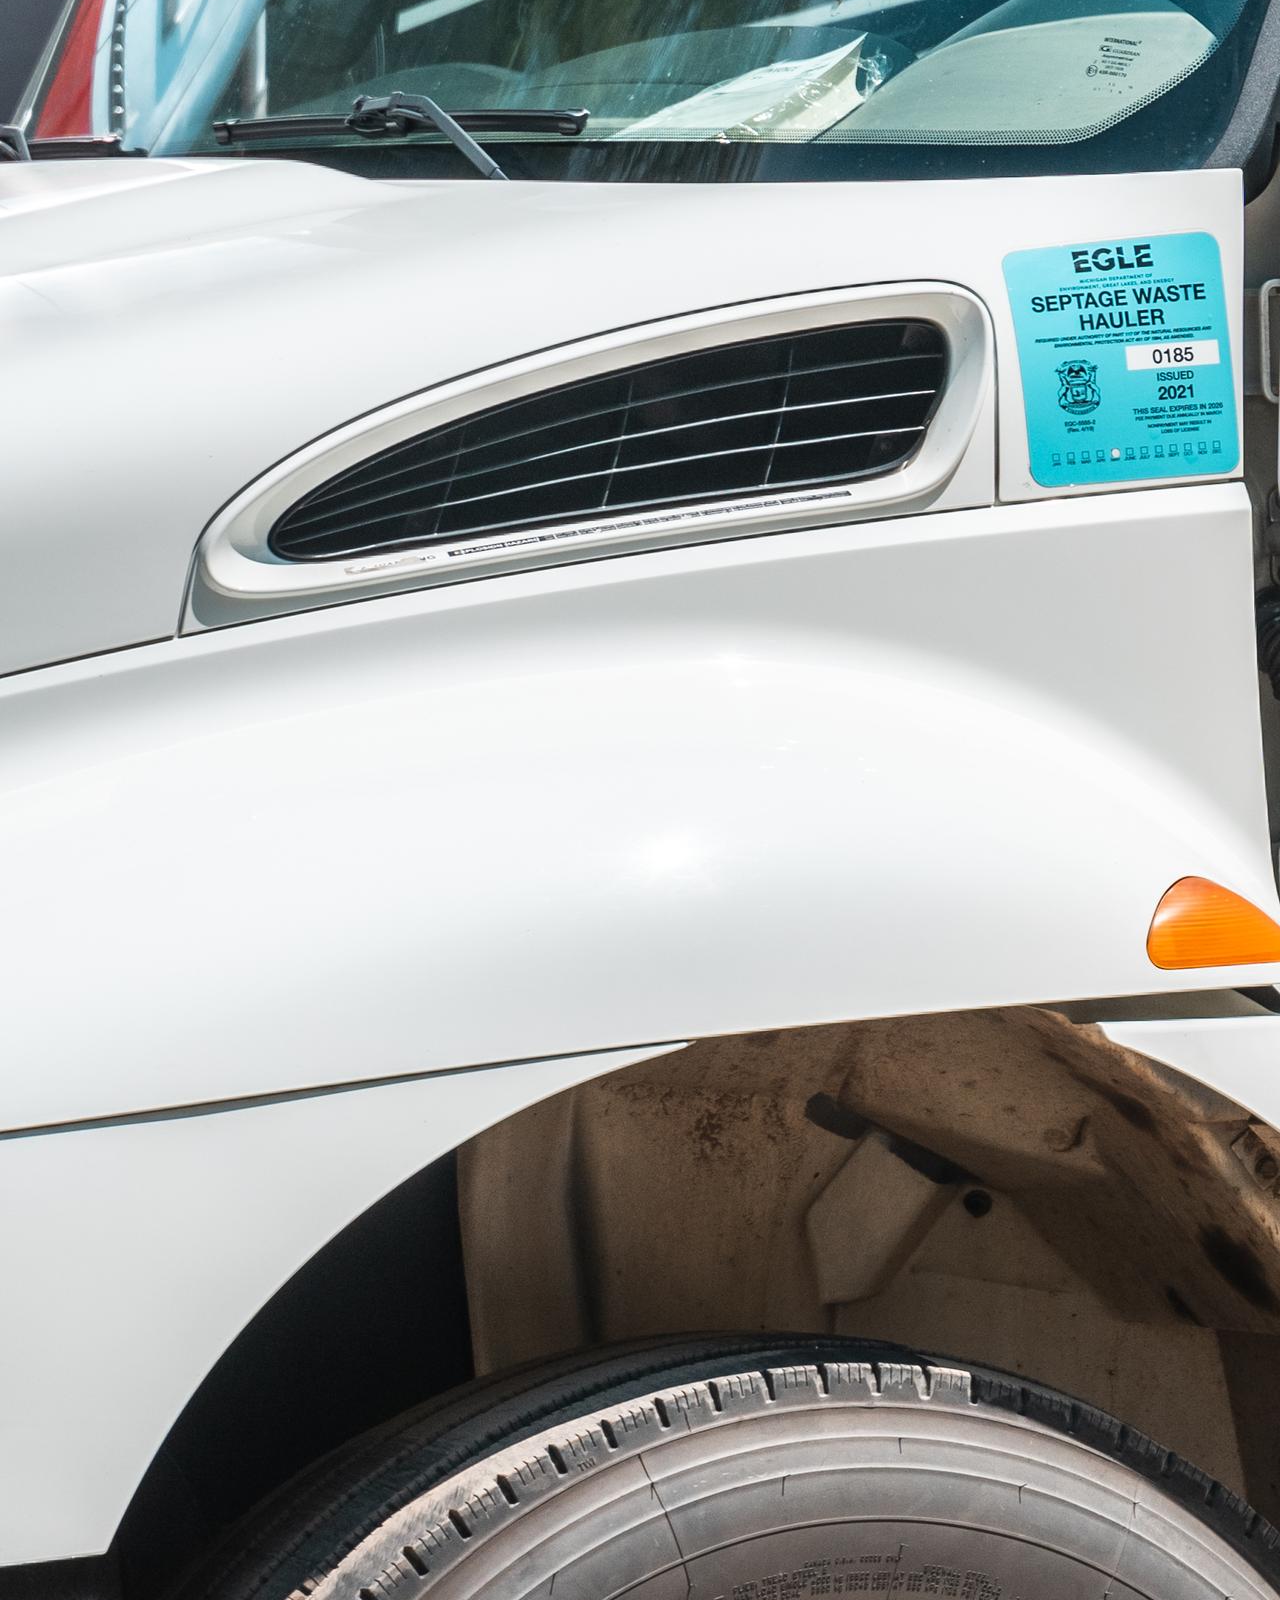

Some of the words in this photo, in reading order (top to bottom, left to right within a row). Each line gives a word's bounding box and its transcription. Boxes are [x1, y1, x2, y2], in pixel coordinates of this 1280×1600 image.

[1071, 244, 1154, 273] EGLE
[1031, 289, 1128, 313] SEPTAGE
[1132, 283, 1207, 305] WASTE
[1079, 308, 1165, 331] HAULER
[1152, 347, 1194, 364] 0185
[1156, 370, 1194, 381] ISSUED
[1158, 384, 1195, 400] 2021
[1150, 406, 1168, 414] SEAL
[1169, 403, 1199, 412] EXPIRES
